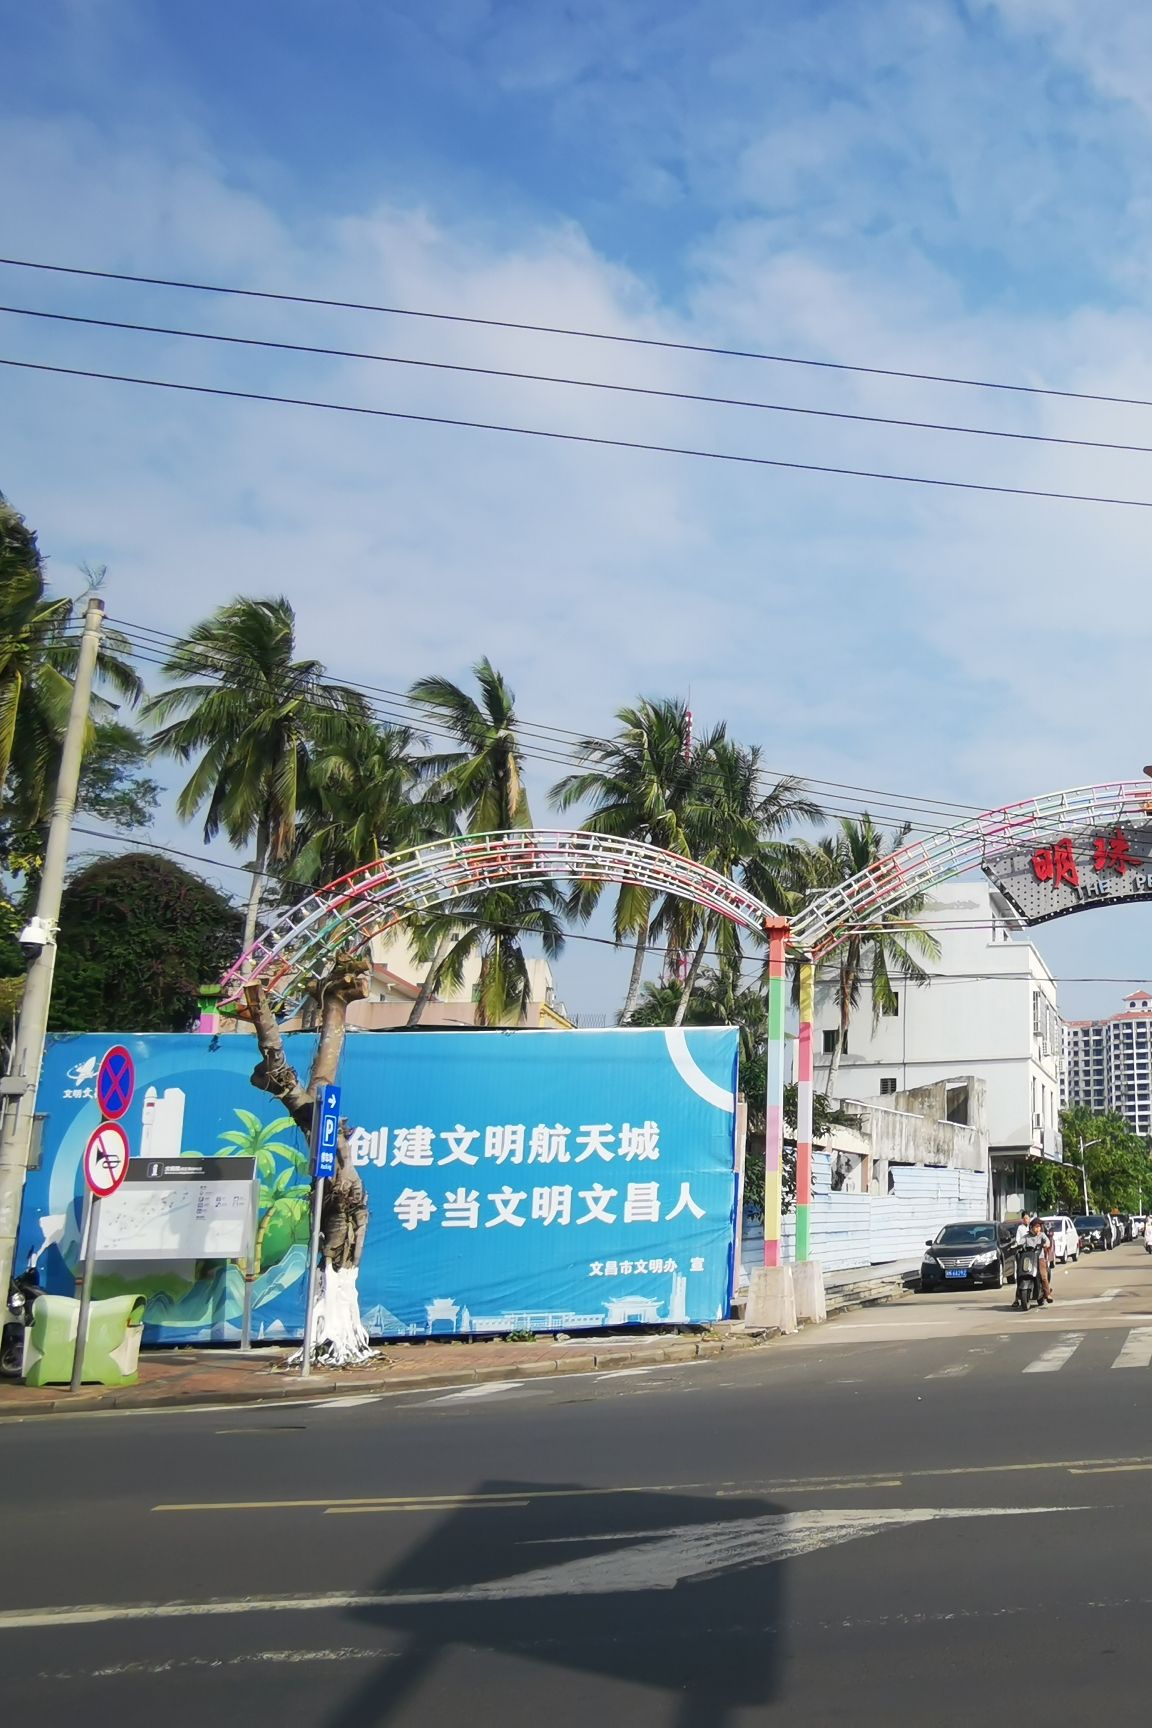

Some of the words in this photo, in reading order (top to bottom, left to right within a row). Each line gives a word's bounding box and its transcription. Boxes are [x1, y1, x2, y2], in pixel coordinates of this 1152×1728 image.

[1074, 878, 1110, 900] THE
[63, 1087, 98, 1099] 文明文
[325, 1119, 334, 1142] P
[348, 1121, 661, 1168] 创建文明航天城
[393, 1181, 706, 1231] 争当文明文昌人
[588, 1258, 678, 1277] 文昌市文明办
[689, 1257, 705, 1272] 宣
